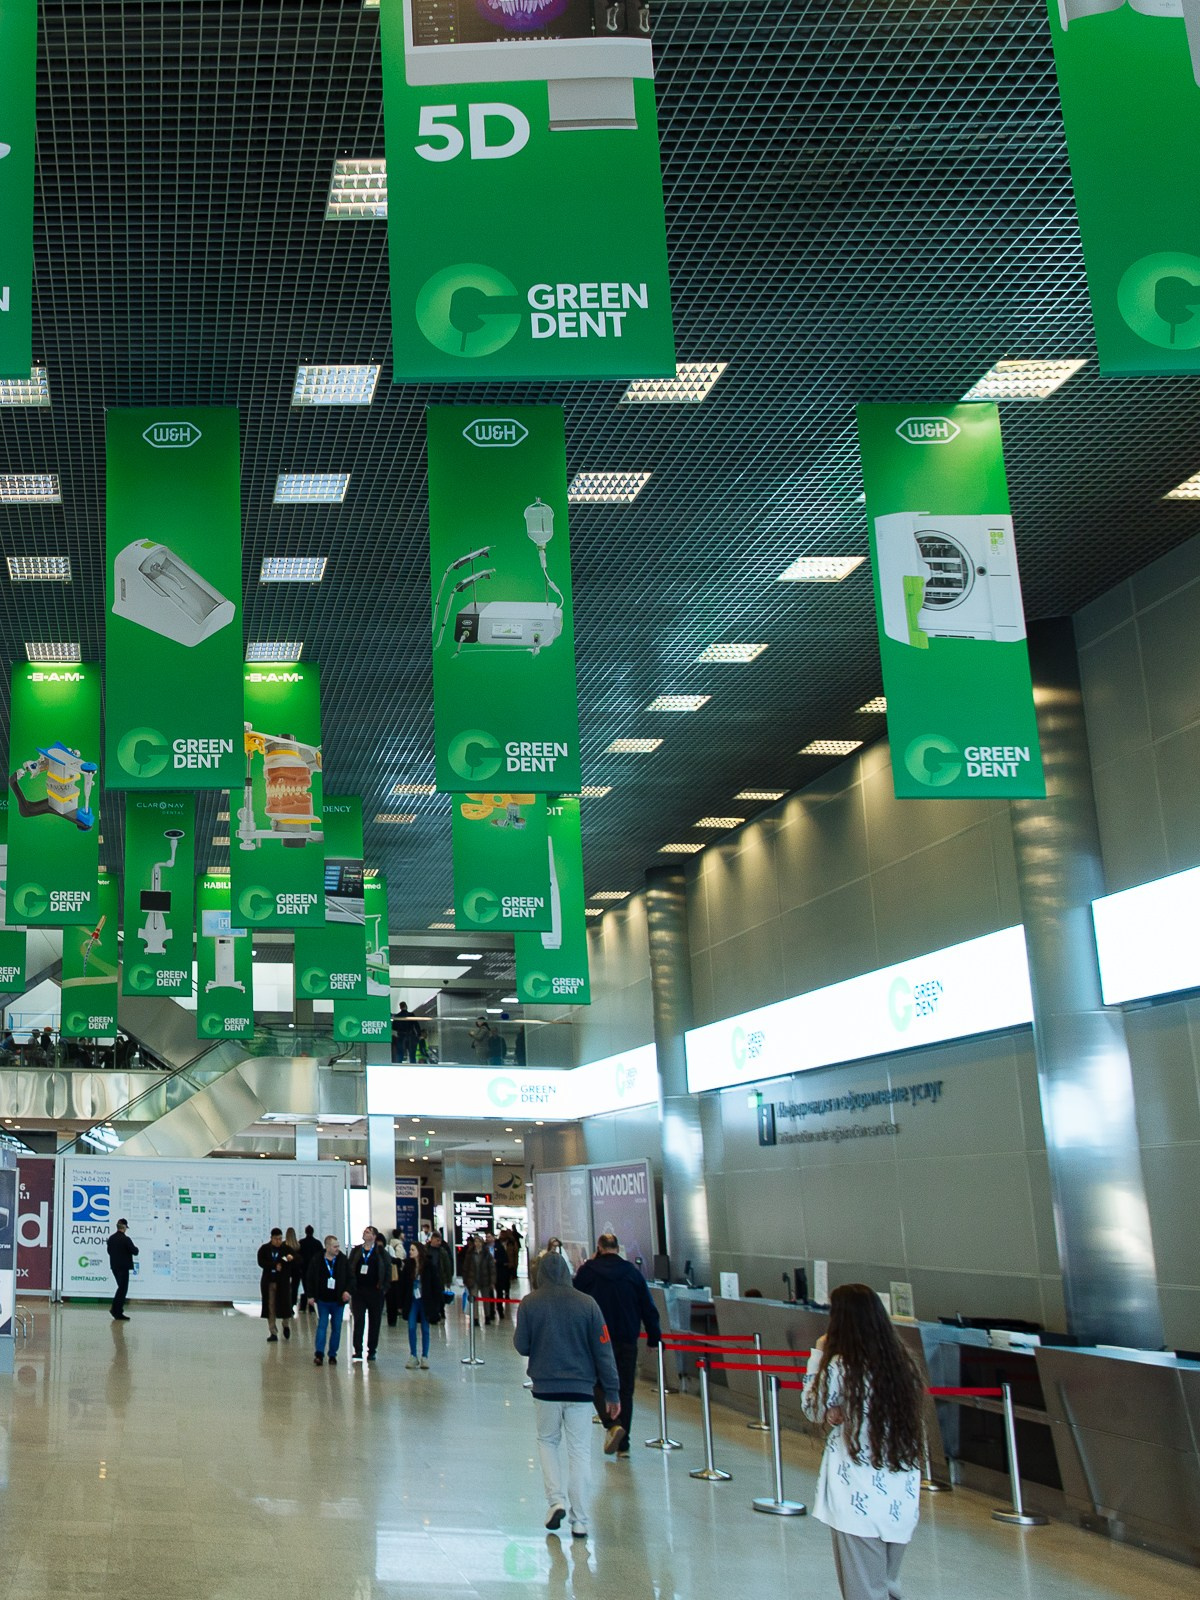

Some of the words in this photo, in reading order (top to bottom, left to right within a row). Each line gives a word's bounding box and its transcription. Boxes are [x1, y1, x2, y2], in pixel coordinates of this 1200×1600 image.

[413, 102, 530, 162] 5D
[527, 283, 648, 310] GREEN
[530, 312, 627, 338] DENT
[153, 427, 191, 443] W&H
[474, 424, 517, 441] W&H
[907, 421, 949, 438] W&H
[172, 738, 233, 754] GREEN
[505, 741, 569, 757] GREEN
[963, 746, 1031, 762] GREEN
[174, 753, 222, 769] DENT
[506, 757, 557, 772] DENT
[966, 761, 1019, 778] DENT
[49, 891, 90, 902] GREEN
[276, 893, 318, 905] GREEN
[501, 896, 544, 908] GREEN
[50, 902, 83, 912] DENT
[276, 904, 311, 915] DENT
[502, 907, 536, 918] DENT
[156, 970, 188, 980] GREEN
[329, 973, 362, 983] GREEN
[156, 978, 182, 987] DENT
[330, 981, 356, 990] DENT
[552, 977, 584, 987] GREEN
[552, 985, 579, 995] DENT
[914, 980, 943, 1000] GREEN
[915, 997, 938, 1017] DENT
[88, 1016, 114, 1024] GREEN
[224, 1017, 250, 1025] GREEN
[361, 1020, 387, 1028] GREEN
[88, 1022, 109, 1030] DENT
[224, 1024, 246, 1032] DENT
[361, 1026, 382, 1035] DENT
[520, 1085, 556, 1094] GREEN
[521, 1094, 549, 1103] DENT
[592, 1172, 645, 1196] NOVGODENT
[71, 1225, 110, 1235] ДЕНТАЛ
[73, 1236, 109, 1245] САЛОН
